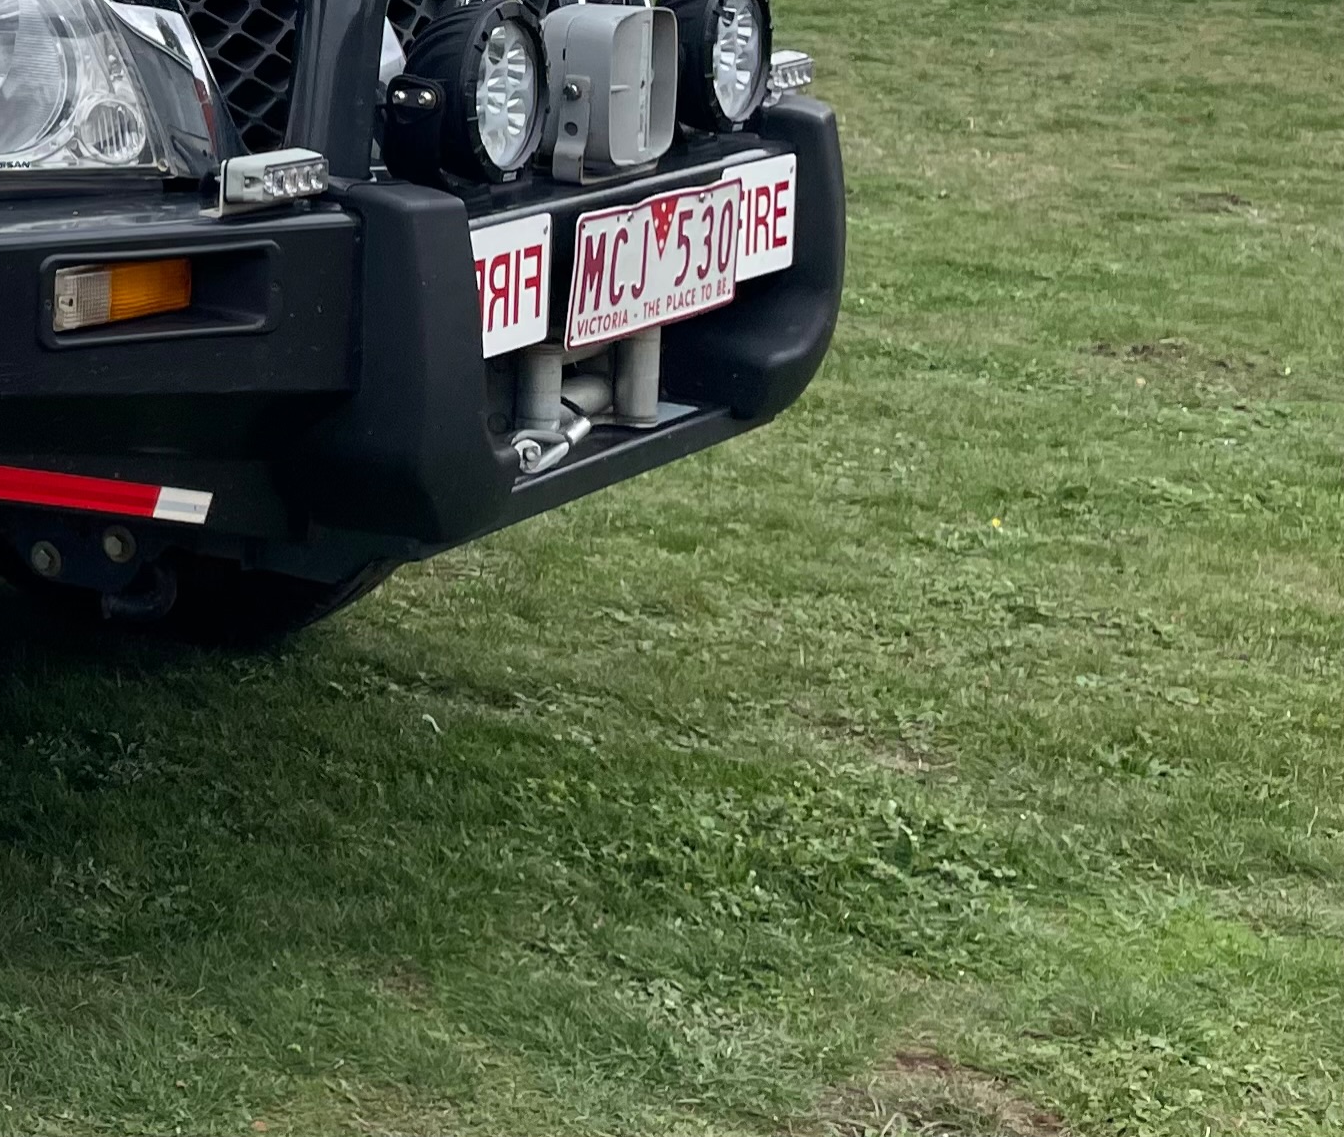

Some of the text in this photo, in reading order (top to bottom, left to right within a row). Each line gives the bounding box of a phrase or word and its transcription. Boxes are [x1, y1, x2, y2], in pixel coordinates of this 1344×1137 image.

[578, 200, 736, 315] MCJ 530
[576, 309, 629, 337] VICTORIA
[643, 300, 662, 320] THE
[666, 290, 697, 315] PLACE
[700, 284, 714, 304] TO
